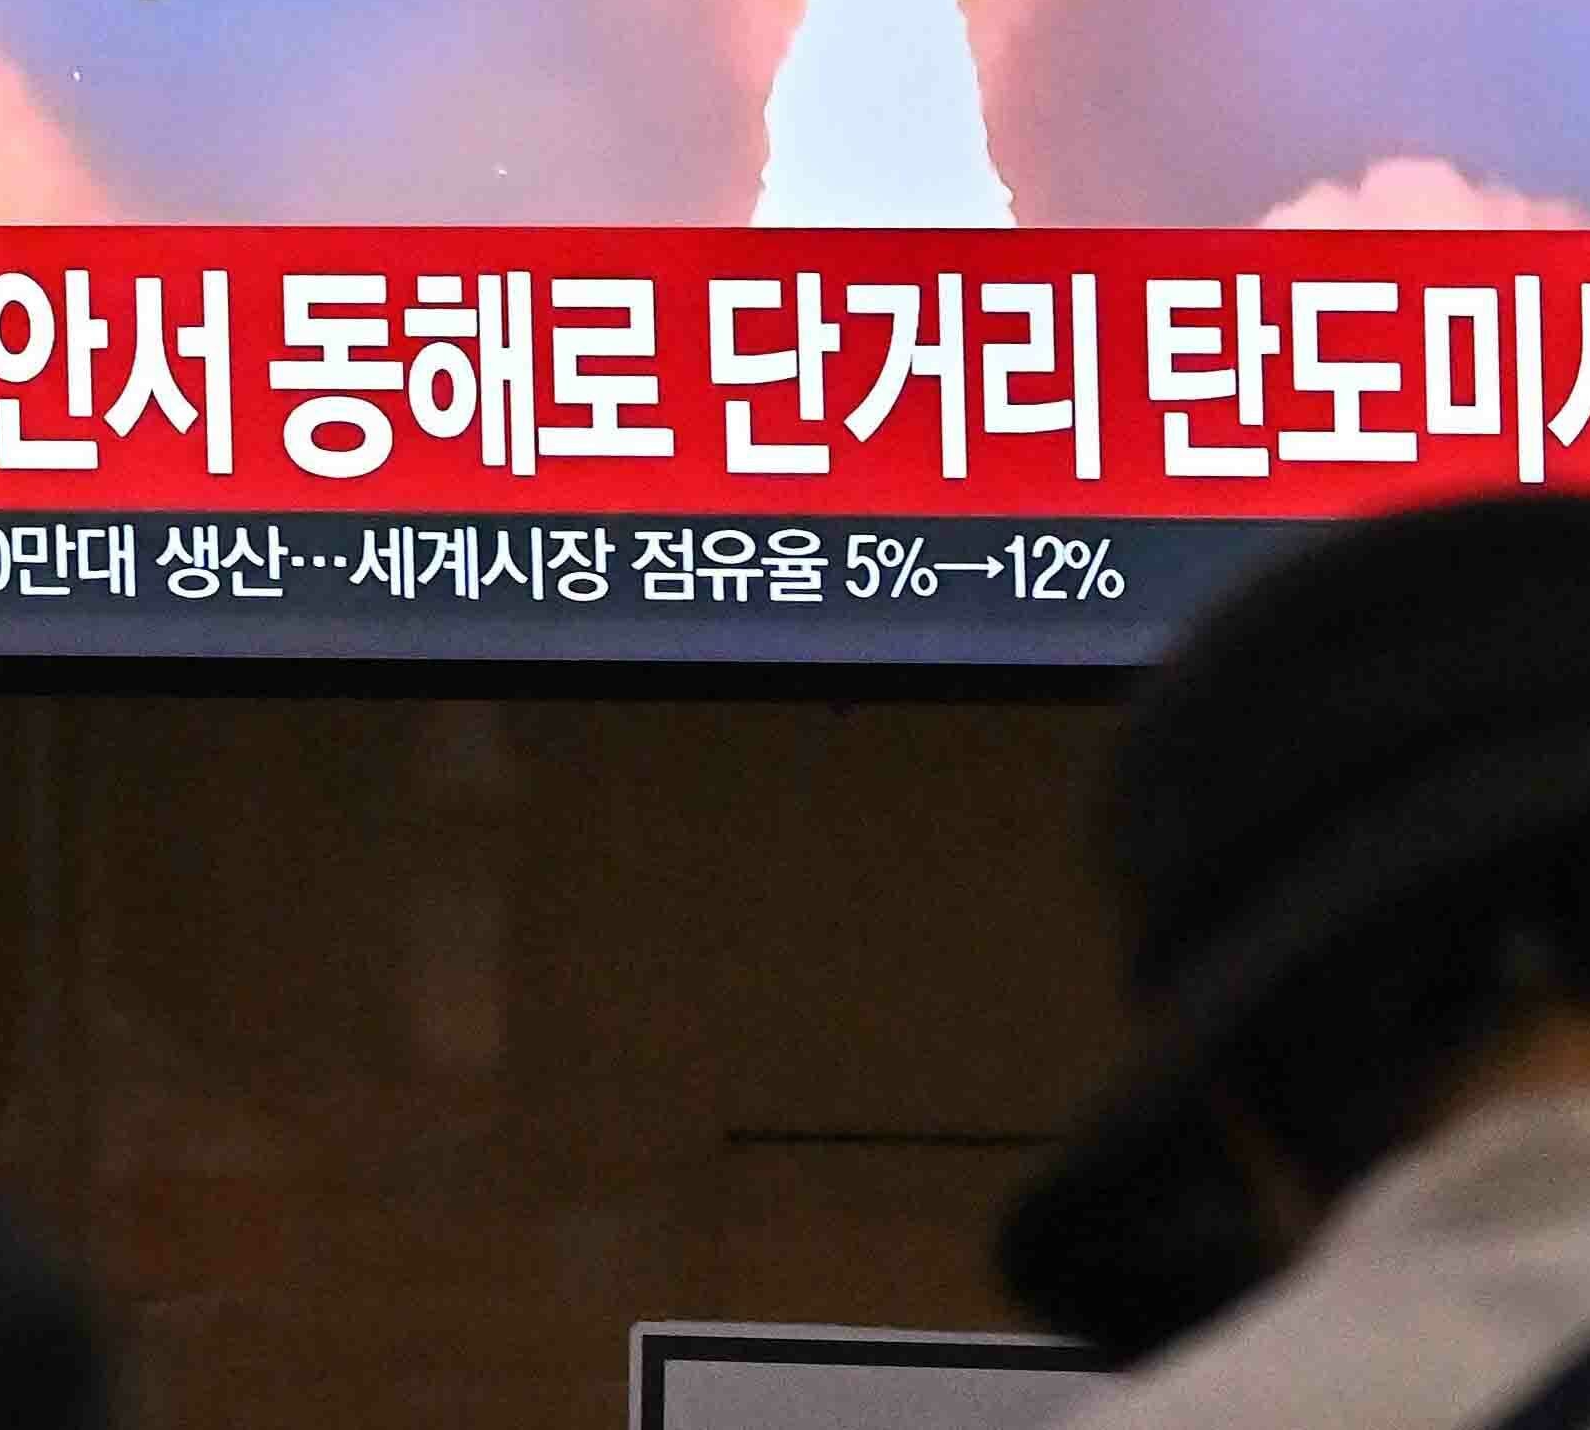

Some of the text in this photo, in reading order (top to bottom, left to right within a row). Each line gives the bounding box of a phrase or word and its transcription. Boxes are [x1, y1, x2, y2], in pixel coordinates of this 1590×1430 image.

[269, 271, 674, 478] 동해로
[708, 272, 1101, 480] 단거리
[631, 528, 829, 602] 점유율
